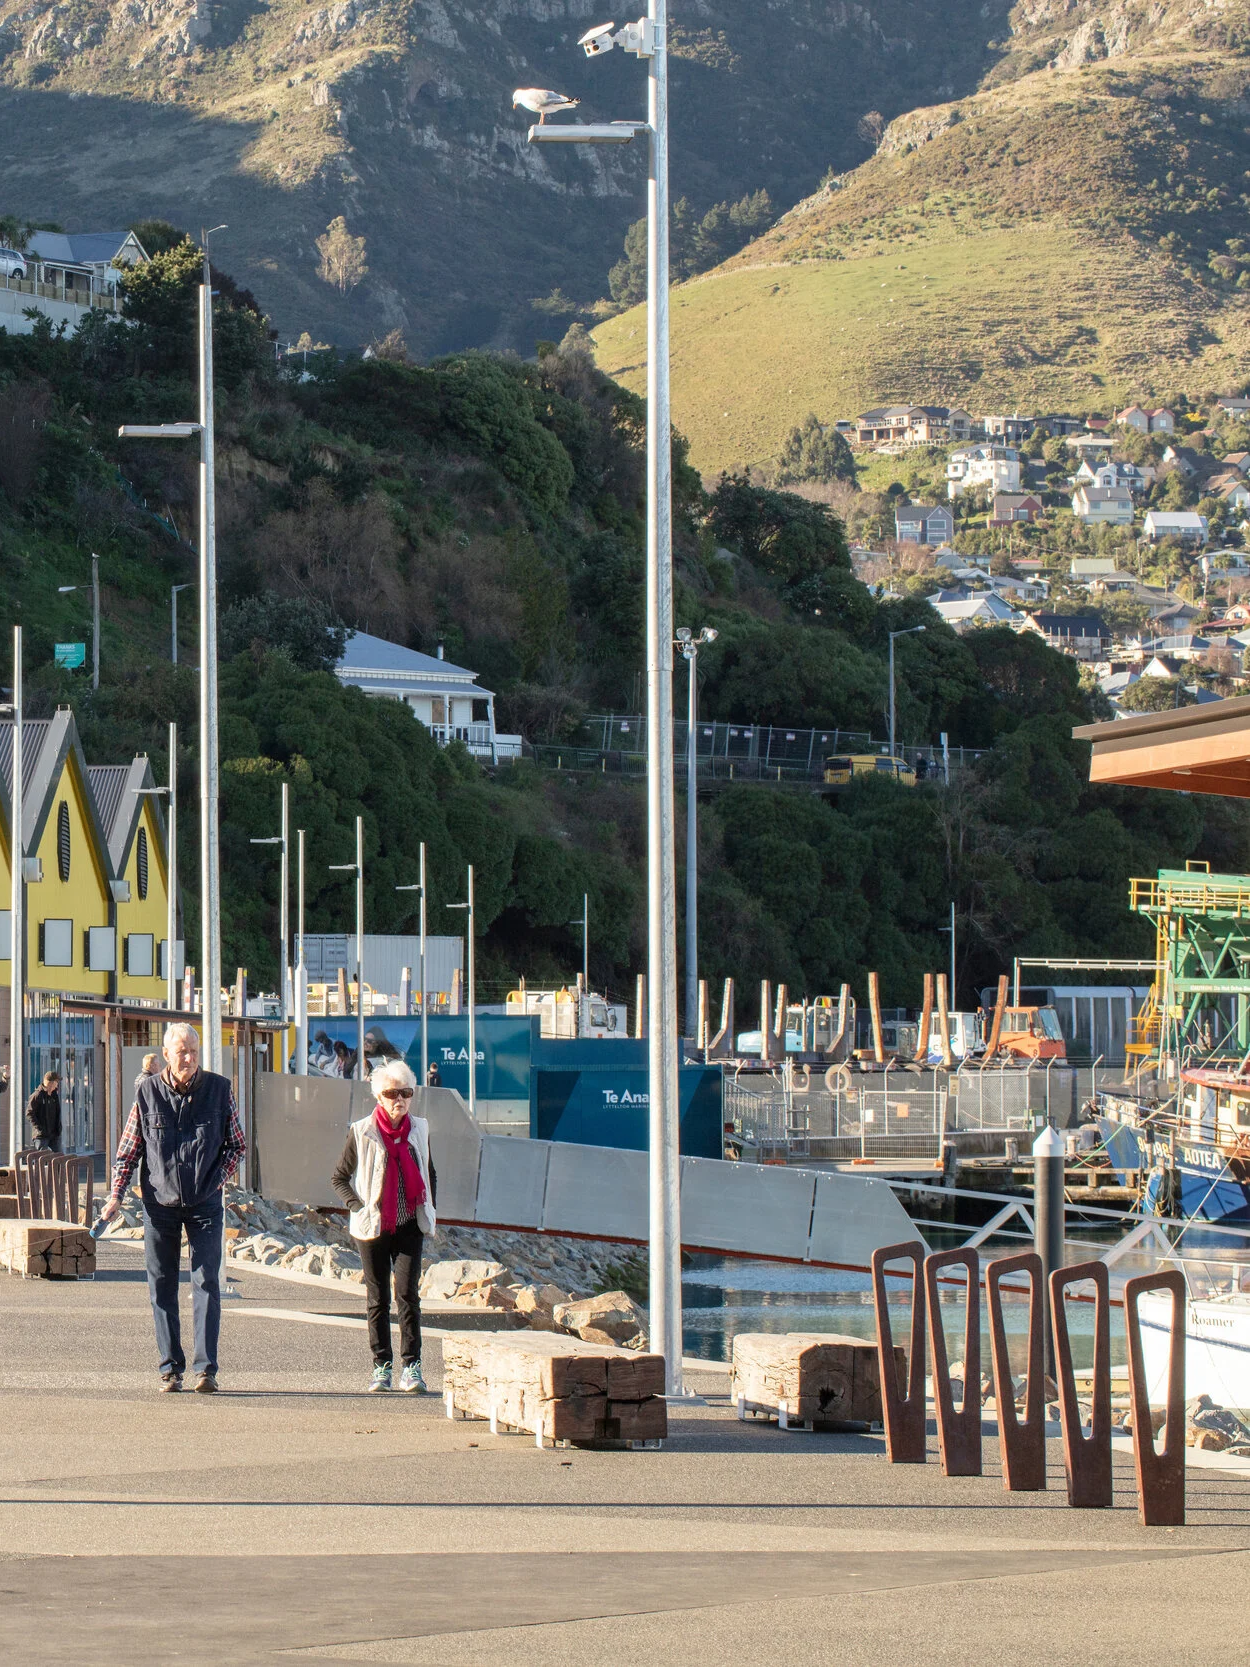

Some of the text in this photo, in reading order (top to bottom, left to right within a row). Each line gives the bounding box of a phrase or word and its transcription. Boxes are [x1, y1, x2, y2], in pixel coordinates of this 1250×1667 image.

[441, 1046, 485, 1060] Te Aa
[602, 1088, 650, 1103] Te Ana
[1184, 1147, 1222, 1170] AOTEA
[1191, 1313, 1235, 1328] Roamer
